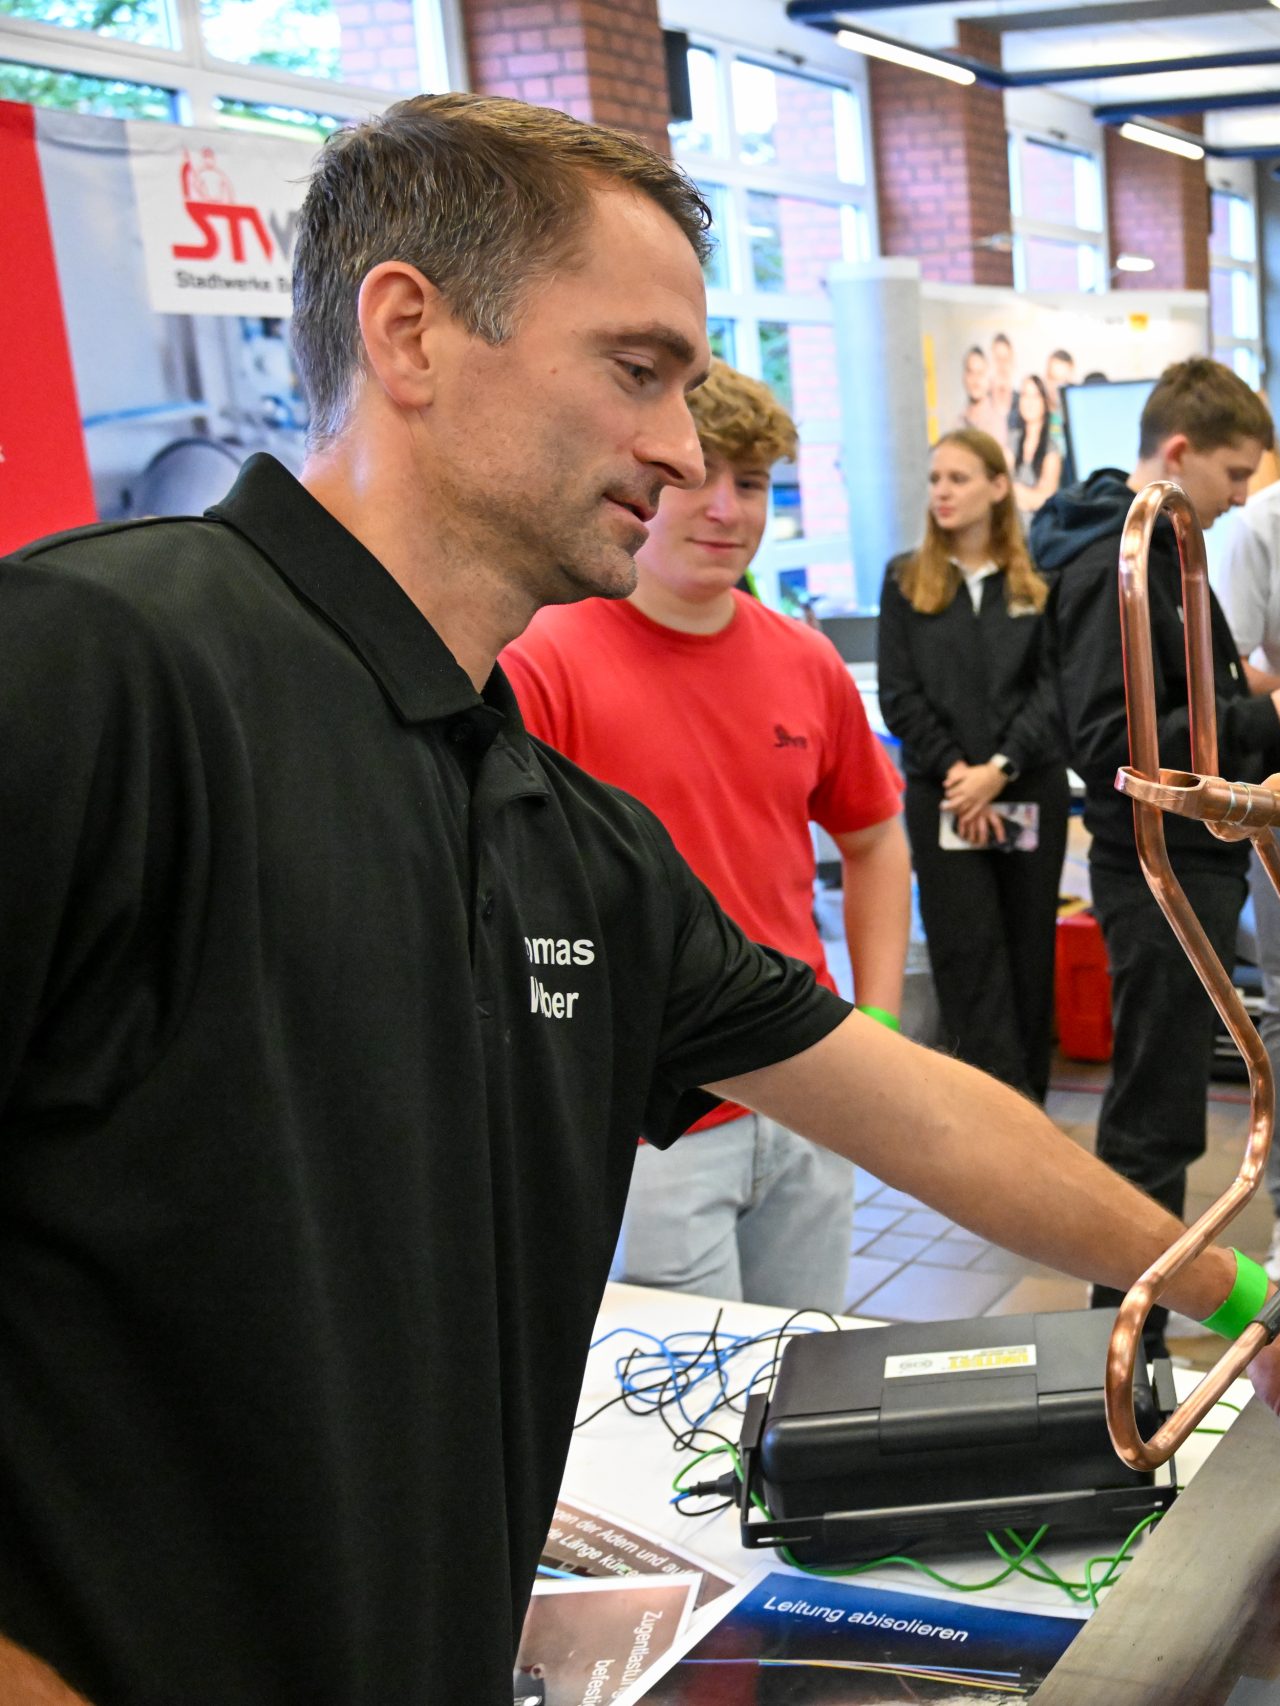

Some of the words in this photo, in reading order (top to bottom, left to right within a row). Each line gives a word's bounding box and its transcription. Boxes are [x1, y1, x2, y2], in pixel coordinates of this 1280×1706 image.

[175, 270, 270, 291] Stadtwerke
[559, 1534, 603, 1559] Länge
[598, 1554, 639, 1577] kürze
[636, 1549, 669, 1567] und
[763, 1596, 845, 1623] Leitung
[847, 1611, 969, 1643] abisolieren
[577, 1659, 616, 1706] befesti
